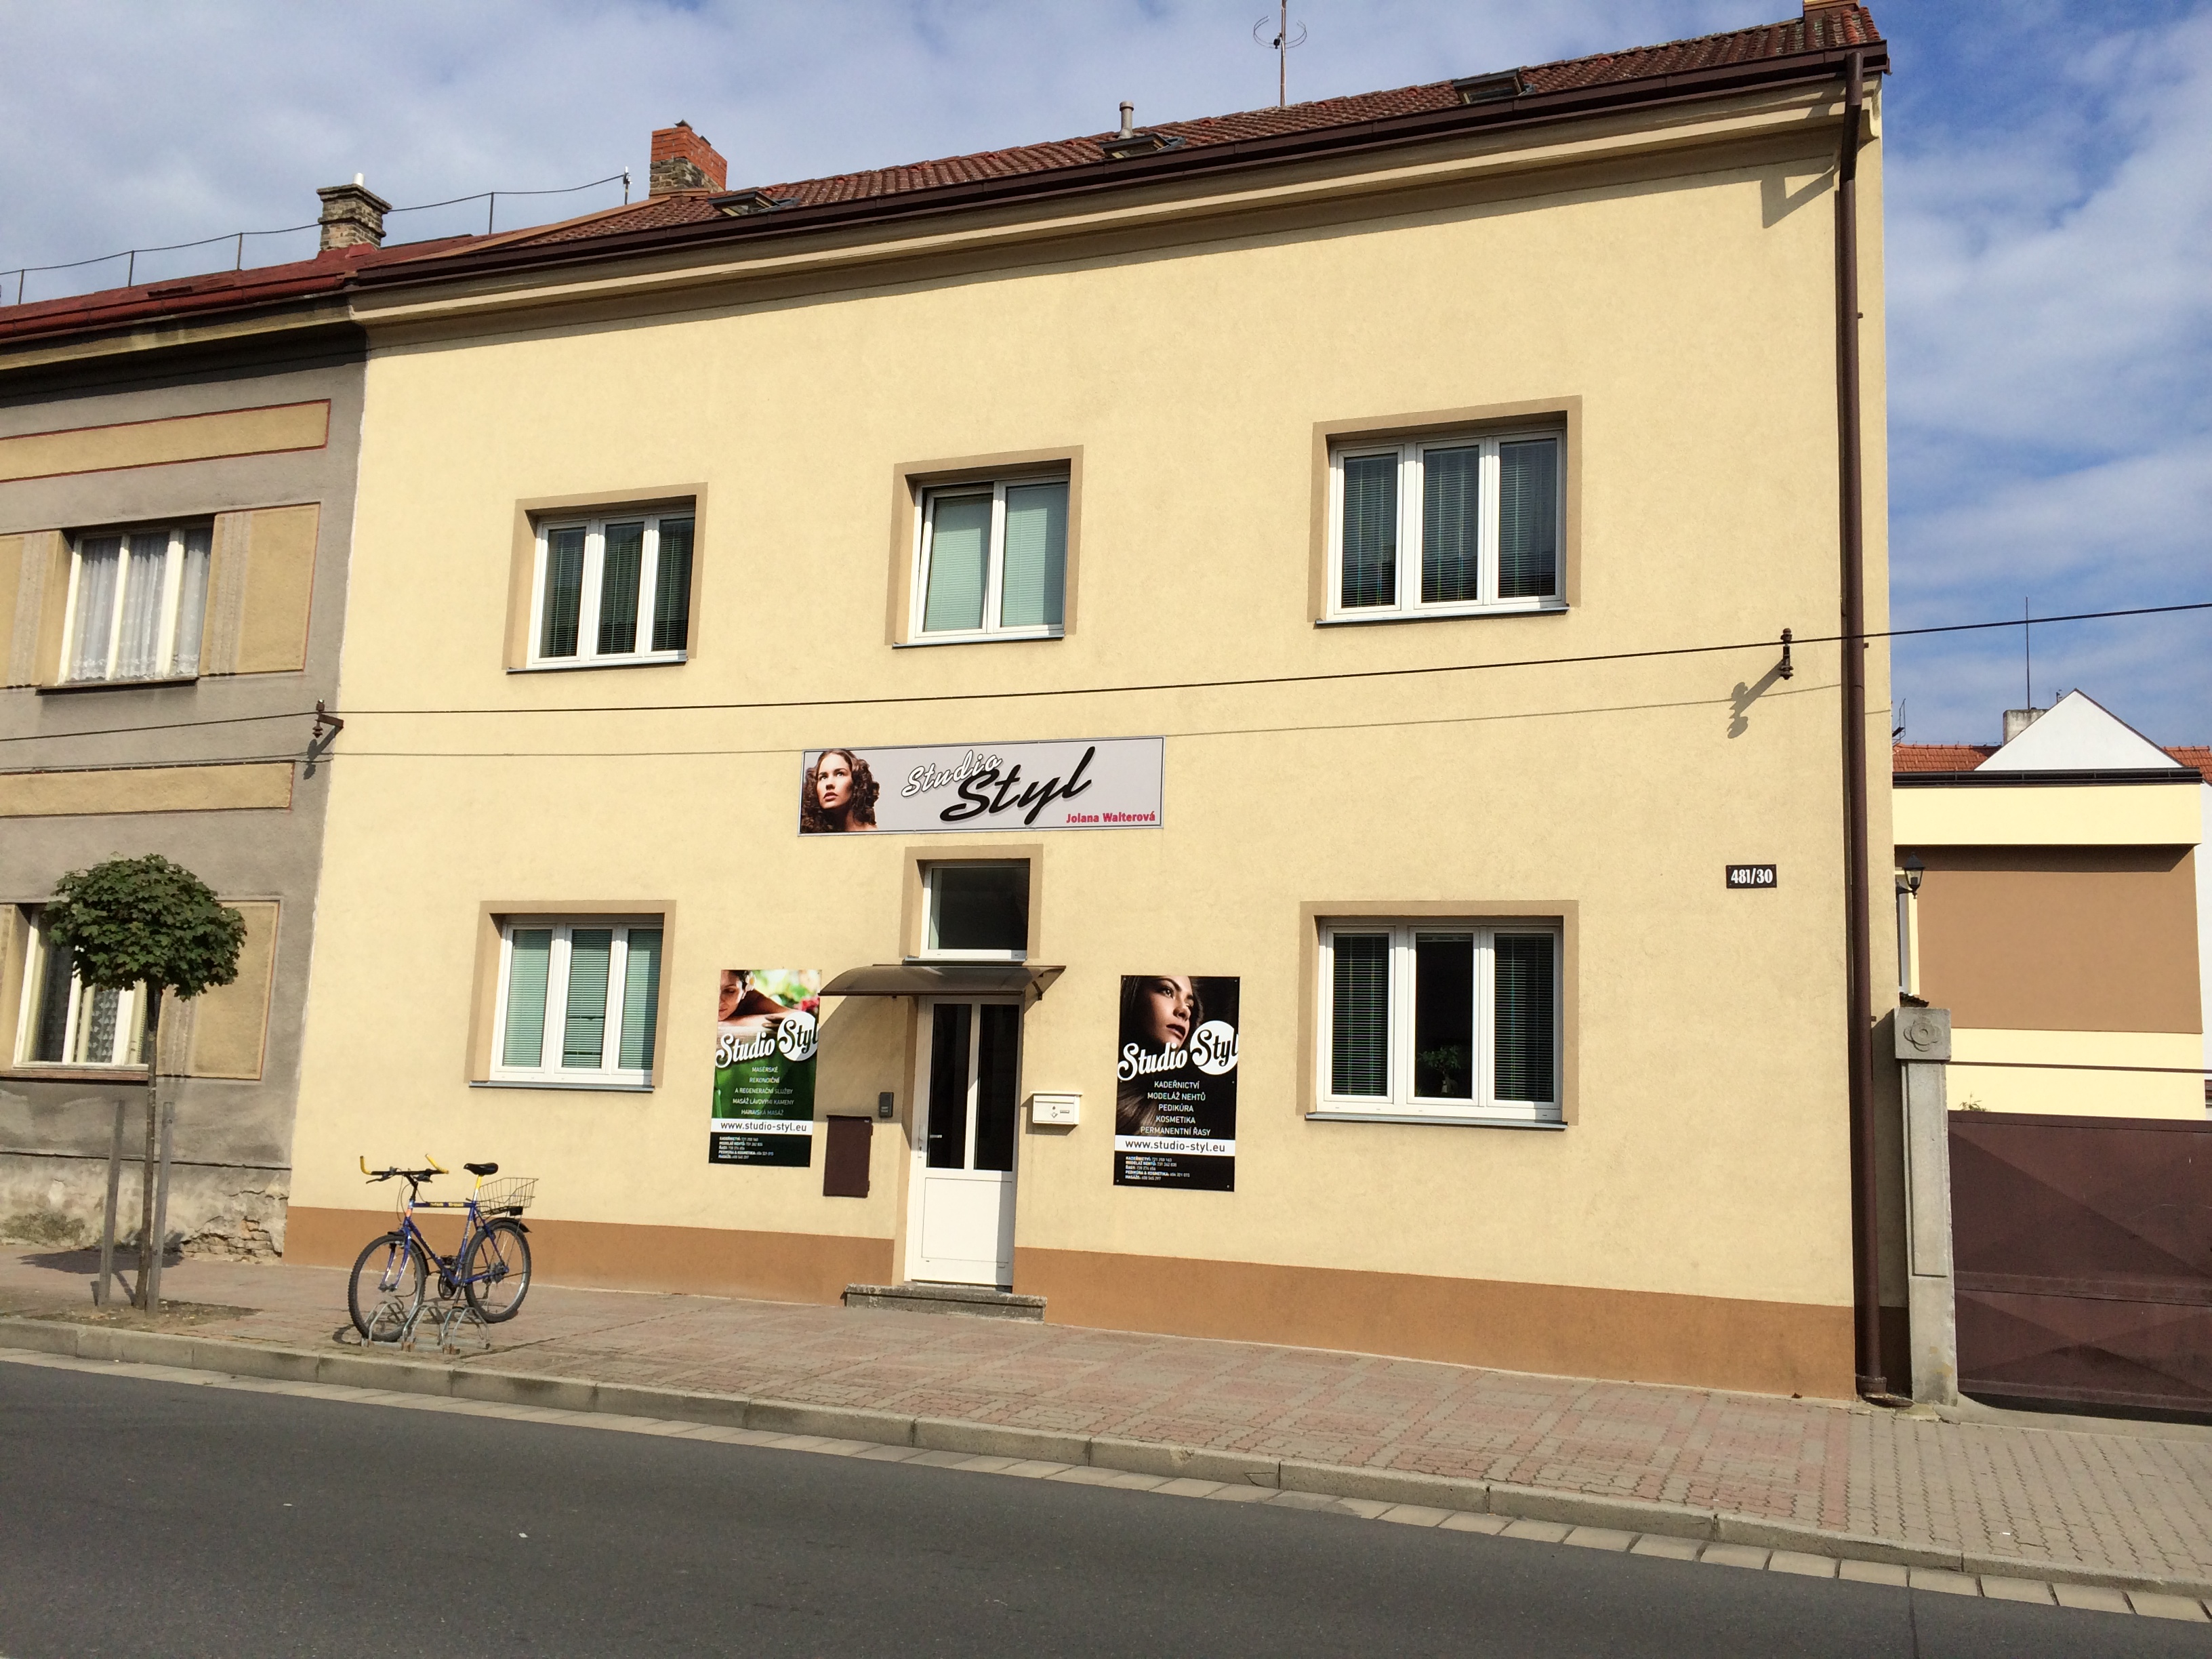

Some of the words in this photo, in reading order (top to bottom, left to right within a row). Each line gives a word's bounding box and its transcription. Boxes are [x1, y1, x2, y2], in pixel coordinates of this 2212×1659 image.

[901, 750, 1003, 798] Studio
[939, 746, 1095, 825] Styl
[1066, 813, 1099, 823] Jolana
[1102, 811, 1155, 823] Walterová
[1731, 867, 1773, 884] 481/30
[716, 1032, 775, 1068] Studio
[779, 1019, 819, 1054] Styl
[1118, 1042, 1187, 1081] Studio
[1191, 1029, 1239, 1067] Styl
[1154, 1080, 1200, 1089] KADEŘNICTVÍ
[1147, 1092, 1180, 1101] MODELÁŽ
[1181, 1092, 1206, 1101] NEHTŮ
[1158, 1103, 1194, 1112] PEDIKÚRA
[1155, 1115, 1195, 1124] KOSMETIKA
[720, 1122, 807, 1133] www.studio-styl.eu
[1141, 1126, 1191, 1135] PERMANENTNÍ
[1193, 1127, 1211, 1136] ŘASY
[1125, 1141, 1225, 1153] www.studio-styl.eu
